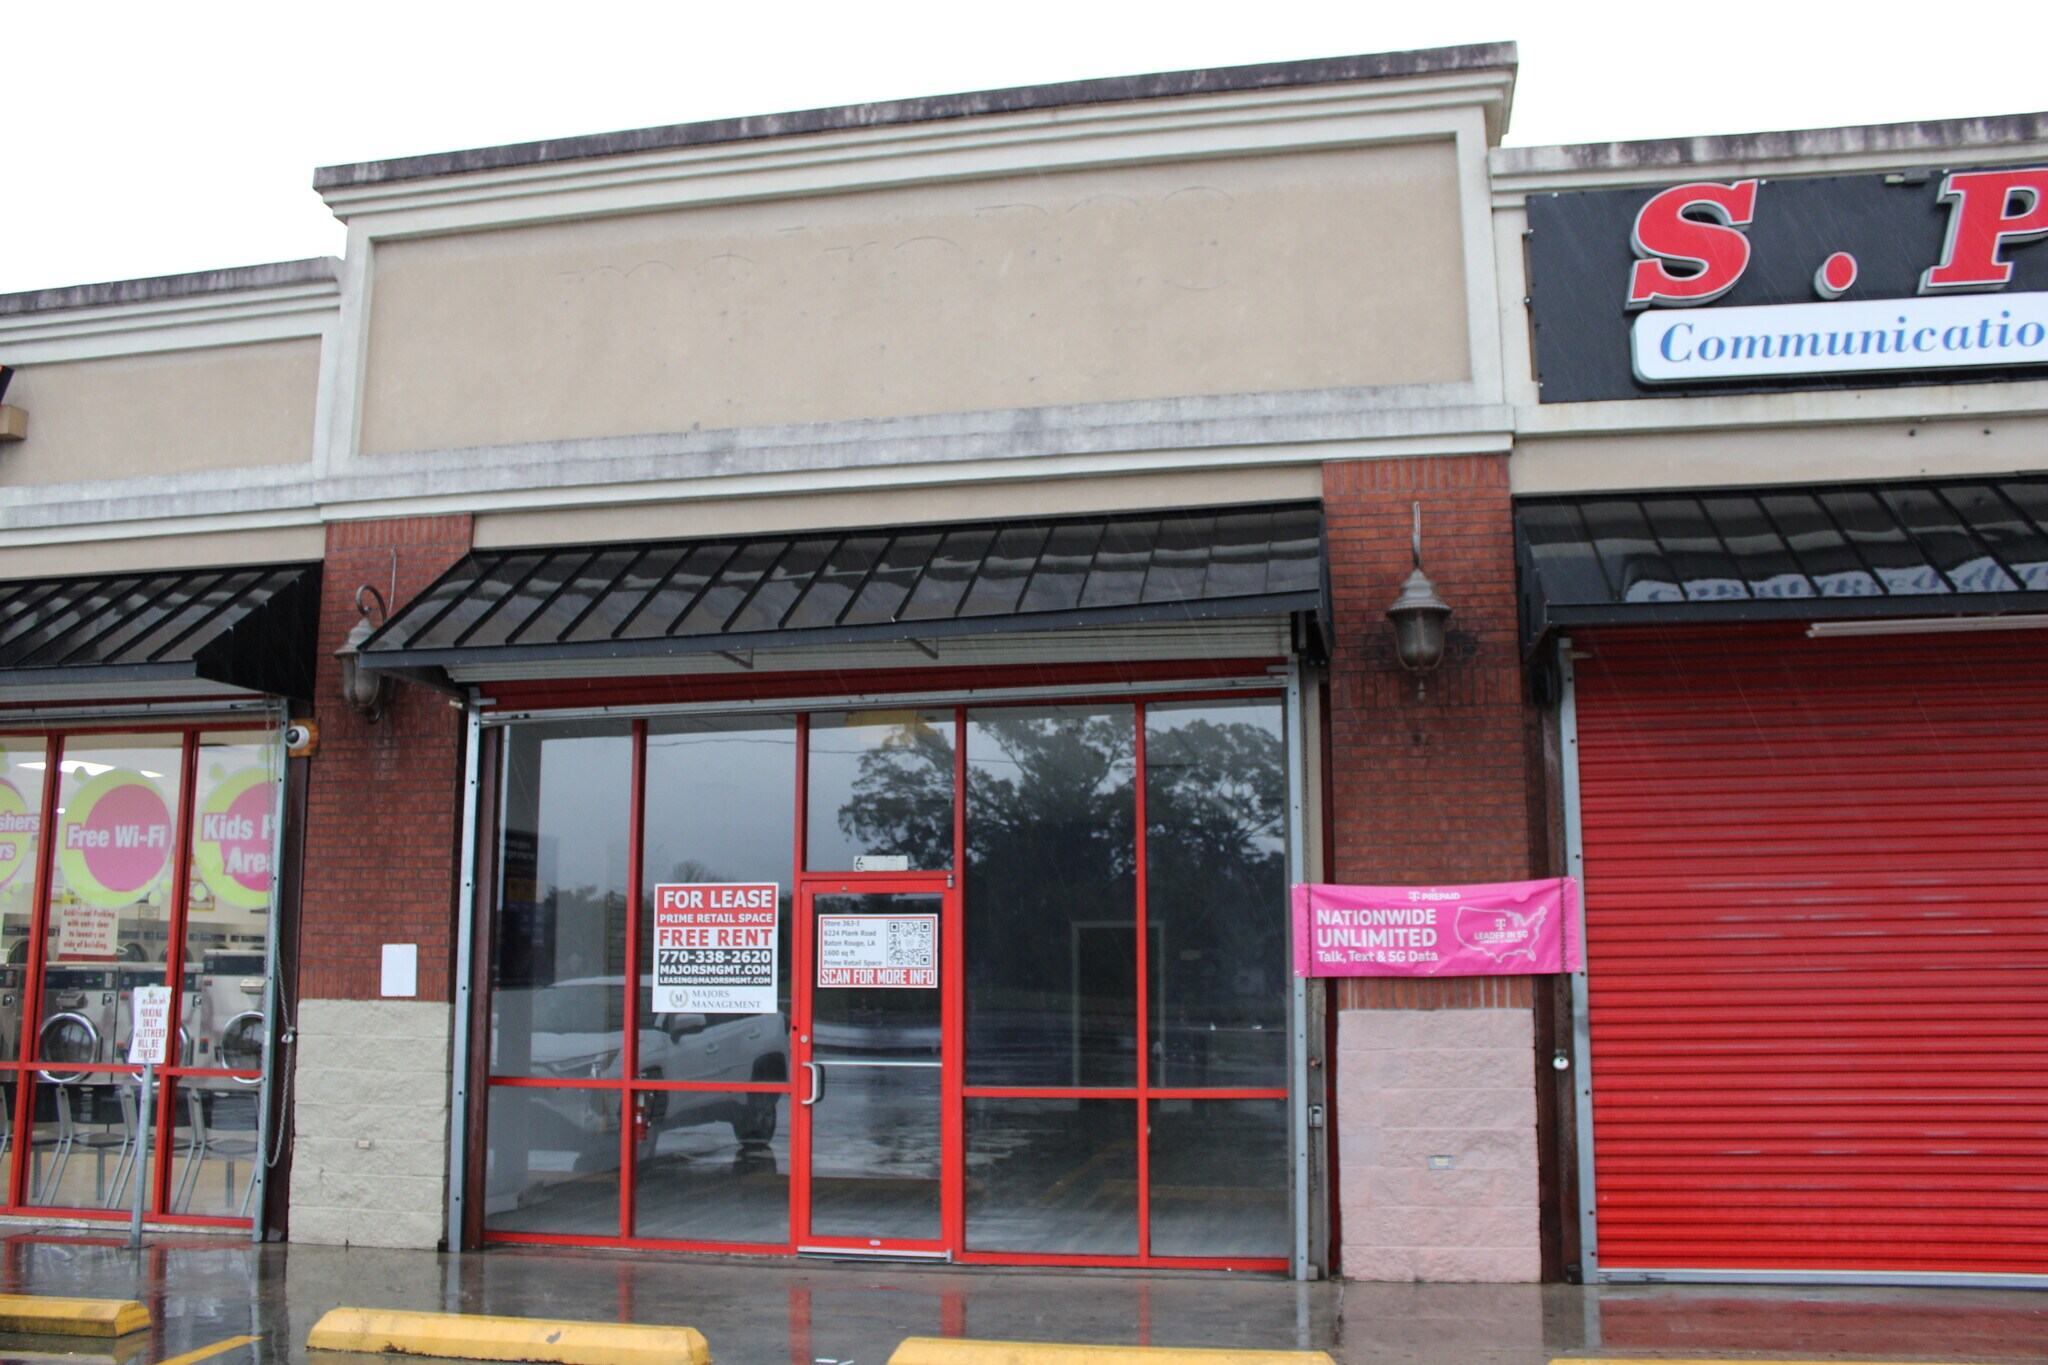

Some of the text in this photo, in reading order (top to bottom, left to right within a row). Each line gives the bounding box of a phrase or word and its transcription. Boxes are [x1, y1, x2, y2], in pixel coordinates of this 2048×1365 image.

[1660, 311, 2046, 363] Communicatio
[203, 814, 253, 840] Kids
[67, 824, 165, 848] Free Wi-Fi
[663, 889, 772, 909] FOR LEASE
[1422, 892, 1460, 900] PREPAID
[94, 909, 115, 919] Parking
[660, 913, 773, 923] PRIME RETAIL SPACE
[1316, 909, 1437, 926] NATIONWIDE
[659, 929, 773, 947] FREE RENT
[1317, 928, 1438, 948] UNLIMITED
[1474, 931, 1505, 940] LEADER
[1507, 931, 1516, 939] IN
[660, 950, 771, 964] 770-338-2620
[1317, 950, 1438, 964] Talk, Text & 5G Data
[660, 964, 771, 975] MAJORSMGMT.COM
[822, 969, 934, 984] SCAN FOR MORE INFO
[659, 976, 771, 985] LEASING@MAJORSMGMT.COM
[692, 990, 730, 999] MAJORS
[691, 1001, 762, 1009] MANAGEMENT
